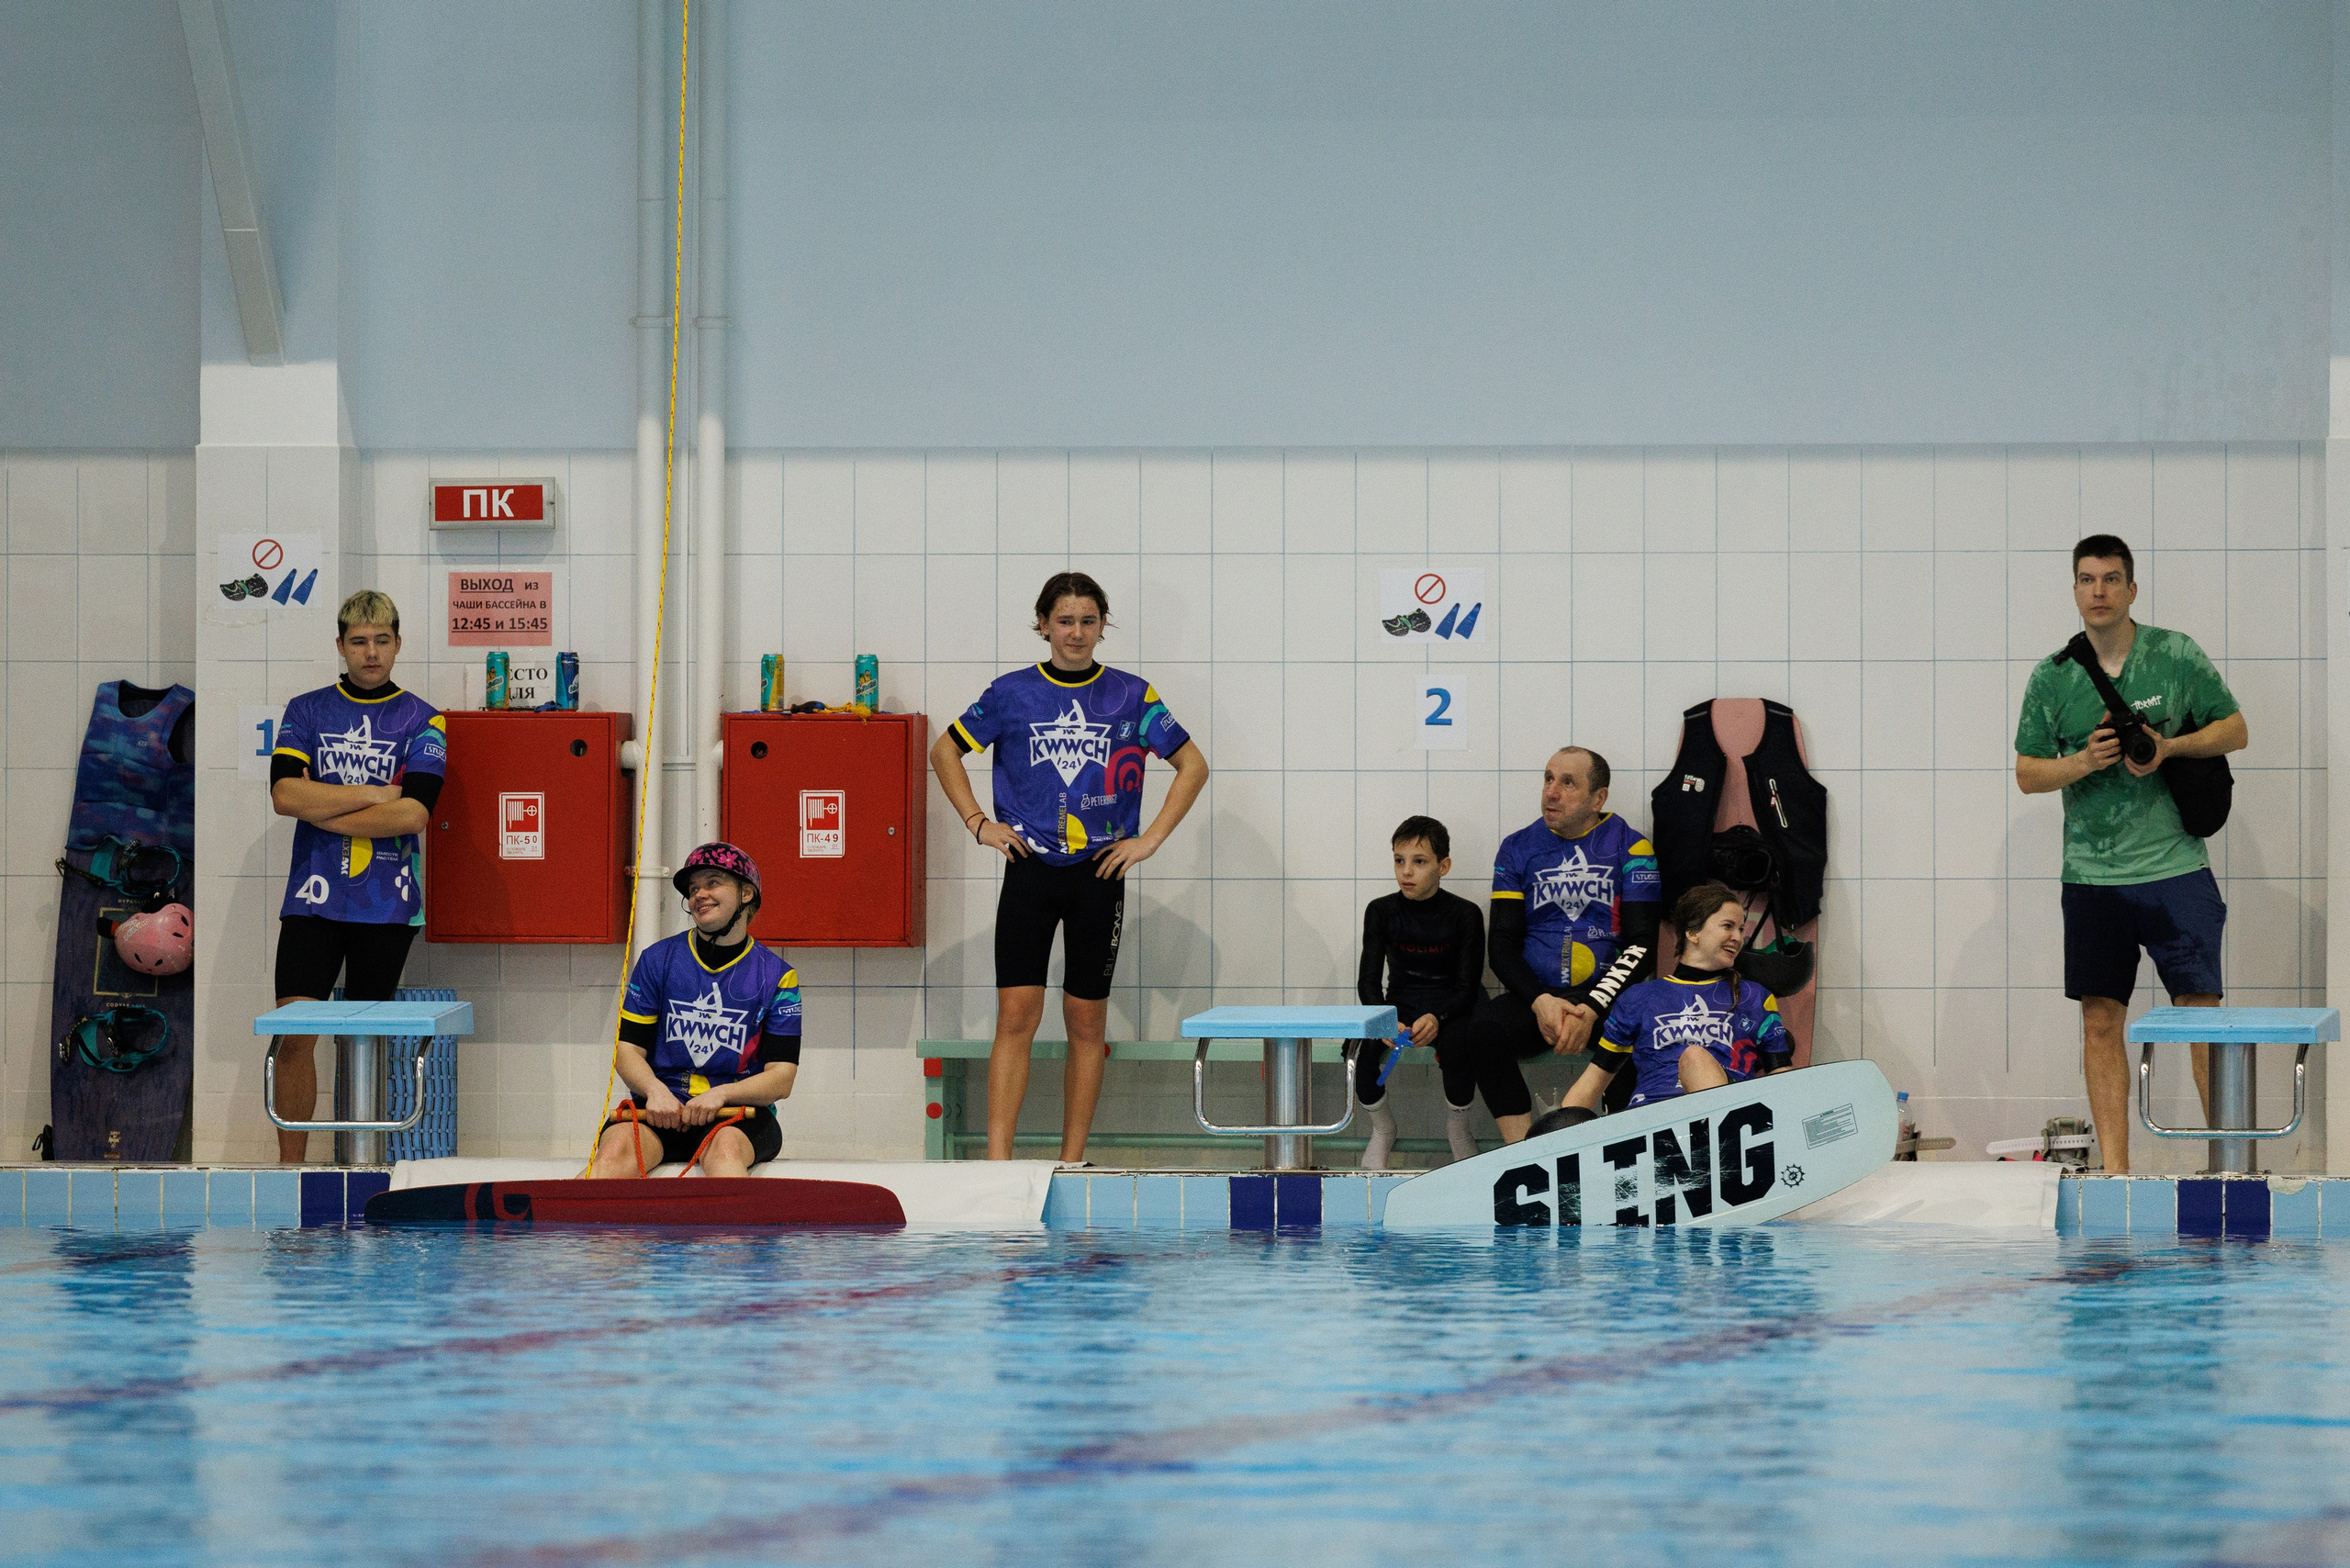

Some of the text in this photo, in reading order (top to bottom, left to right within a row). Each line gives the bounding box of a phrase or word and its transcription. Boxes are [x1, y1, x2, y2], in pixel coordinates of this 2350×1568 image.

[463, 488, 514, 518] ПК
[460, 578, 539, 592] ВЫХОД из
[453, 600, 483, 609] ЧАШИ
[485, 599, 536, 610] БАССЕЙНА
[452, 617, 548, 630] 12:45 и 15:45
[1425, 687, 1453, 726] 2
[256, 719, 274, 756] 1
[1032, 738, 1109, 764] KWWCH
[319, 750, 393, 780] KWWCH
[1061, 760, 1077, 770] 24
[347, 775, 361, 786] 24
[295, 874, 330, 904] 40
[1537, 879, 1612, 904] KWWCH
[1565, 902, 1581, 910] 24
[667, 1015, 744, 1050] KWWCH
[1656, 1023, 1731, 1047] KWWCH
[693, 1044, 709, 1055] 24
[1494, 1102, 1775, 1226] SLING
